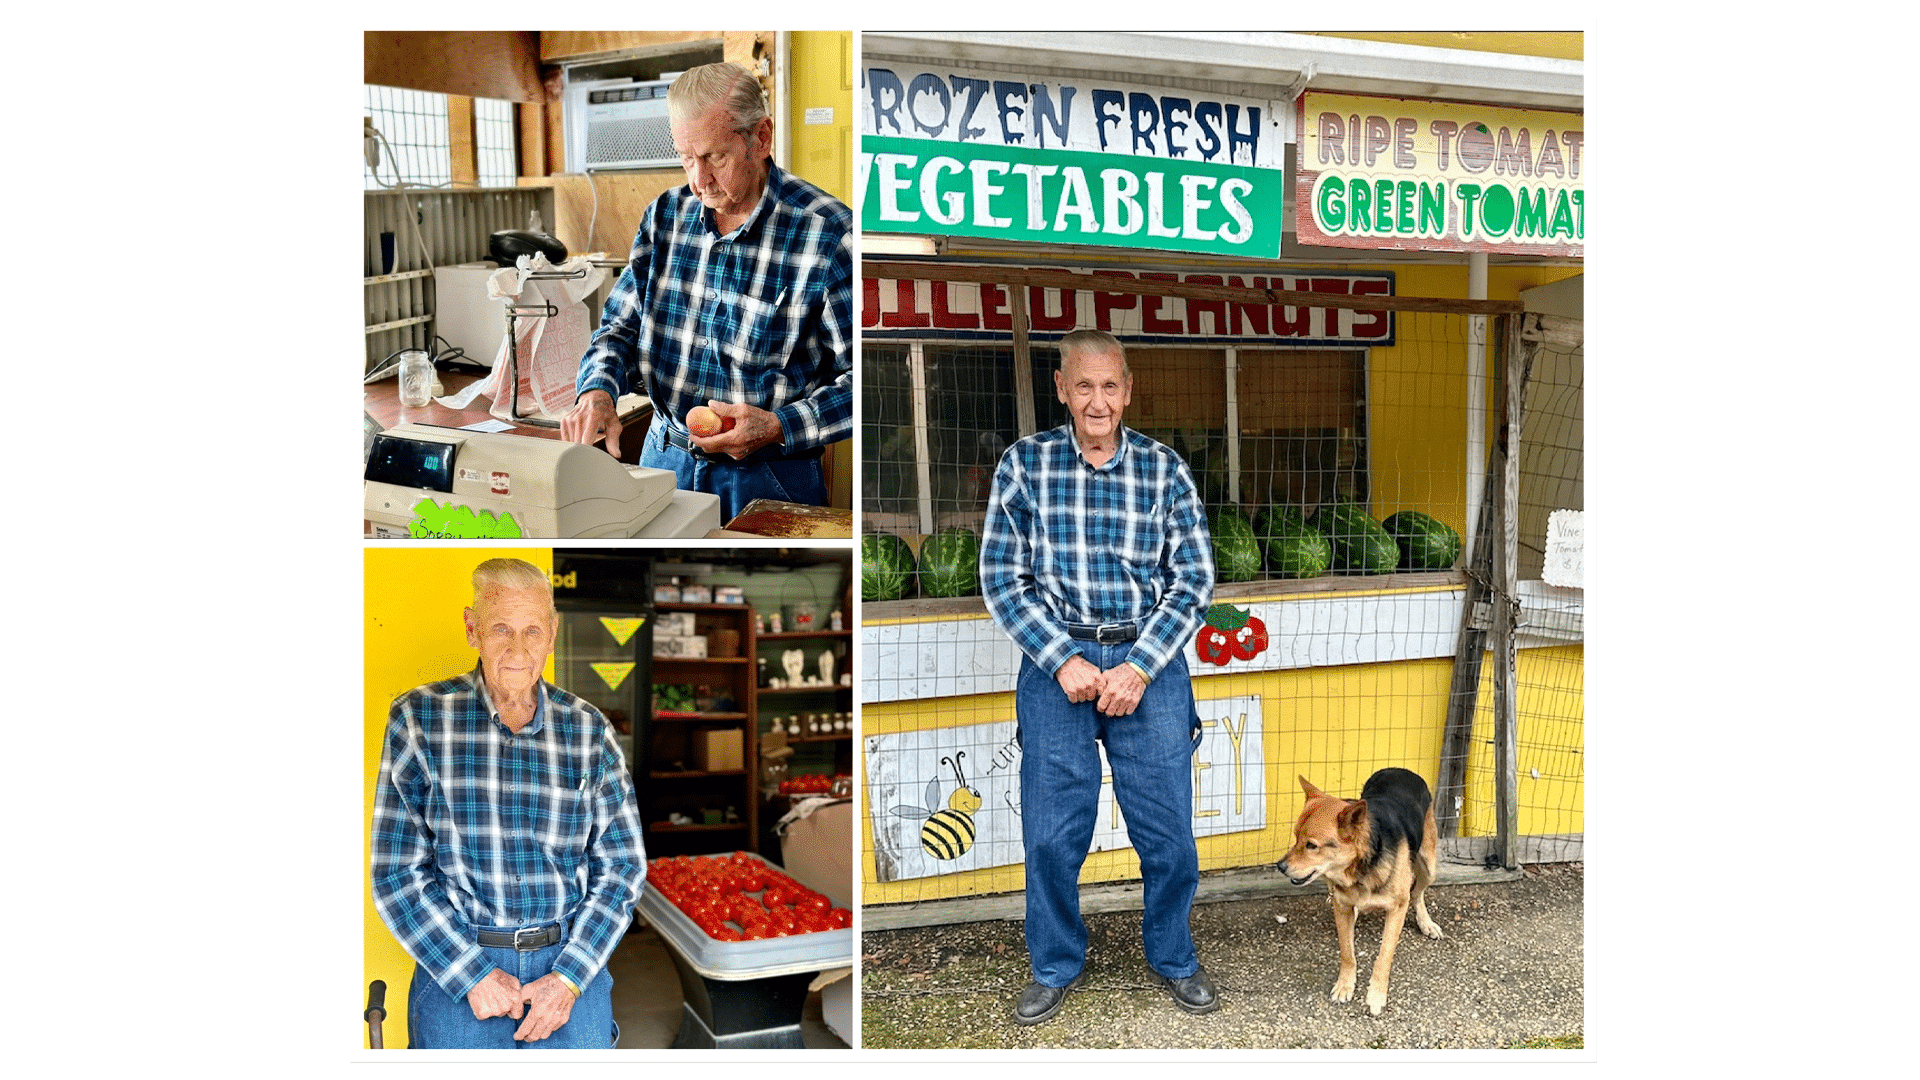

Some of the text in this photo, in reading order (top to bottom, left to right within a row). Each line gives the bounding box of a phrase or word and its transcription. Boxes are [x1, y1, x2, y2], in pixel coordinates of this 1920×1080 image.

[862, 68, 1261, 167] ROZEN FRESH
[1318, 111, 1584, 180] RIPE TOMAT
[1317, 175, 1445, 235] GREEN
[1092, 270, 1388, 338] PEANUTS
